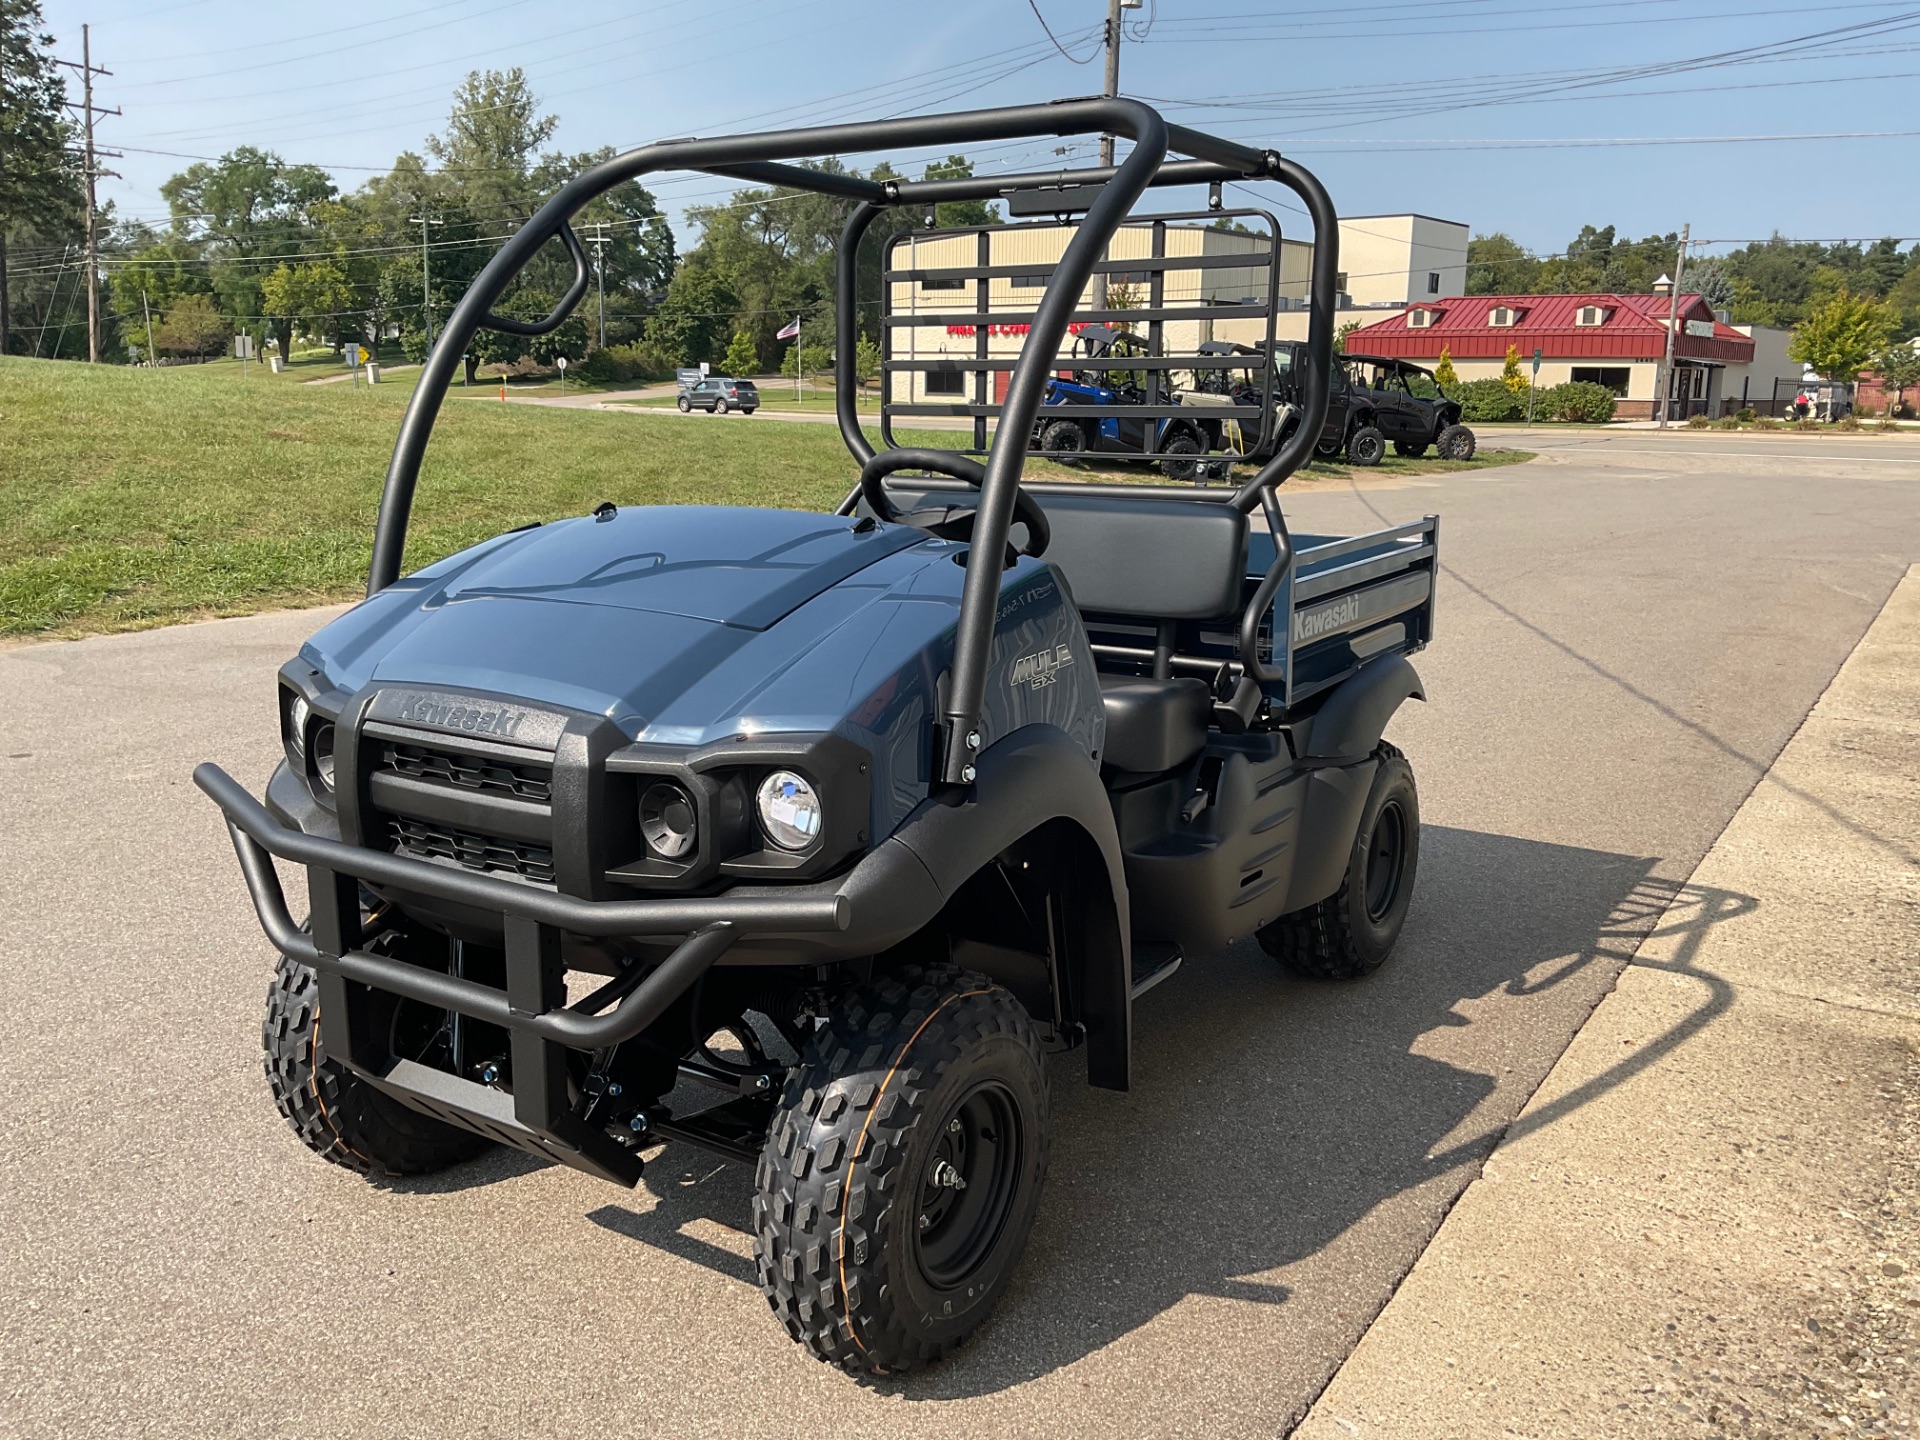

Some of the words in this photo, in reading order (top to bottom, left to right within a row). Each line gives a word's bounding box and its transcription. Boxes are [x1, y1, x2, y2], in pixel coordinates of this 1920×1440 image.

[945, 324, 996, 335] PIRAS
[1293, 593, 1359, 642] Kawasaki
[1010, 643, 1075, 686] MULE
[1031, 671, 1057, 690] SX
[398, 695, 526, 738] Kawasaki
